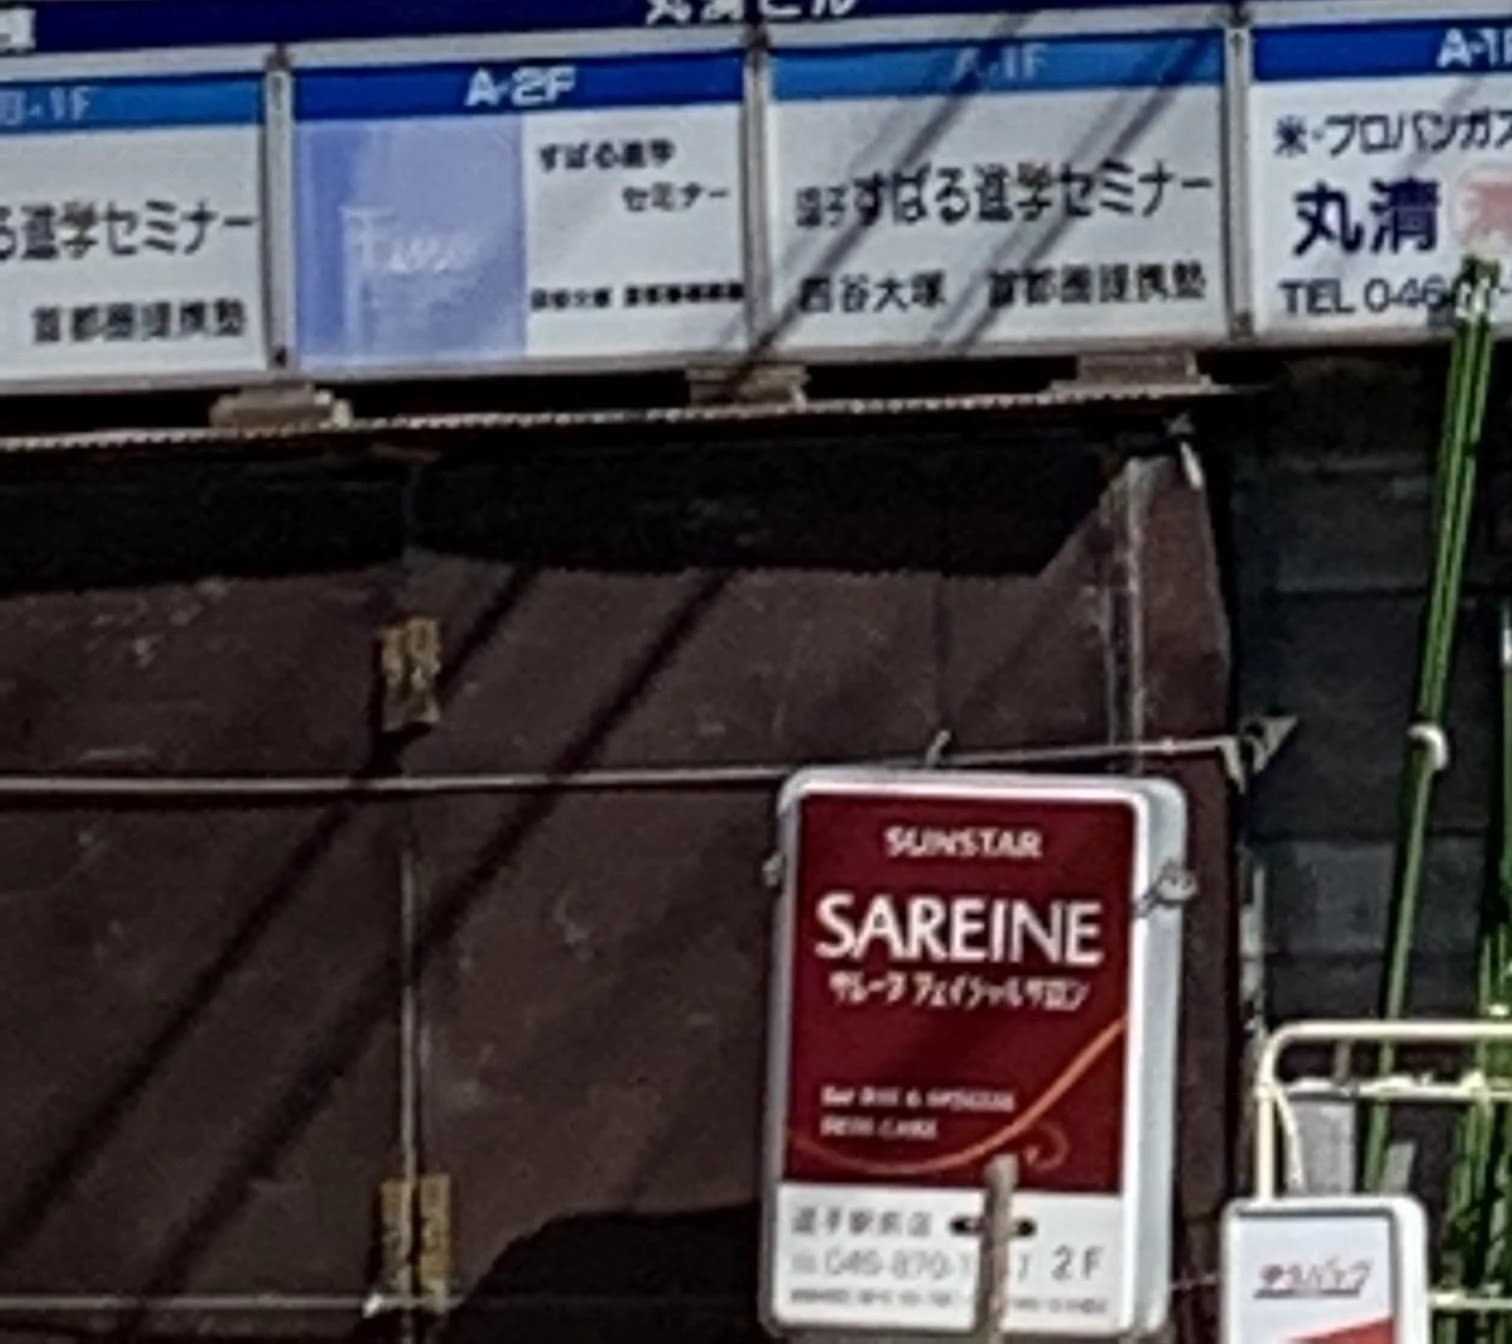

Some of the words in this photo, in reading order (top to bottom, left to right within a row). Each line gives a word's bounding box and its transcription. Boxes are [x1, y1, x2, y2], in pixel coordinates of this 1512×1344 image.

[1278, 278, 1355, 315] TEL
[885, 826, 1043, 860] SUNSTAR
[815, 892, 1105, 966] SAREINE
